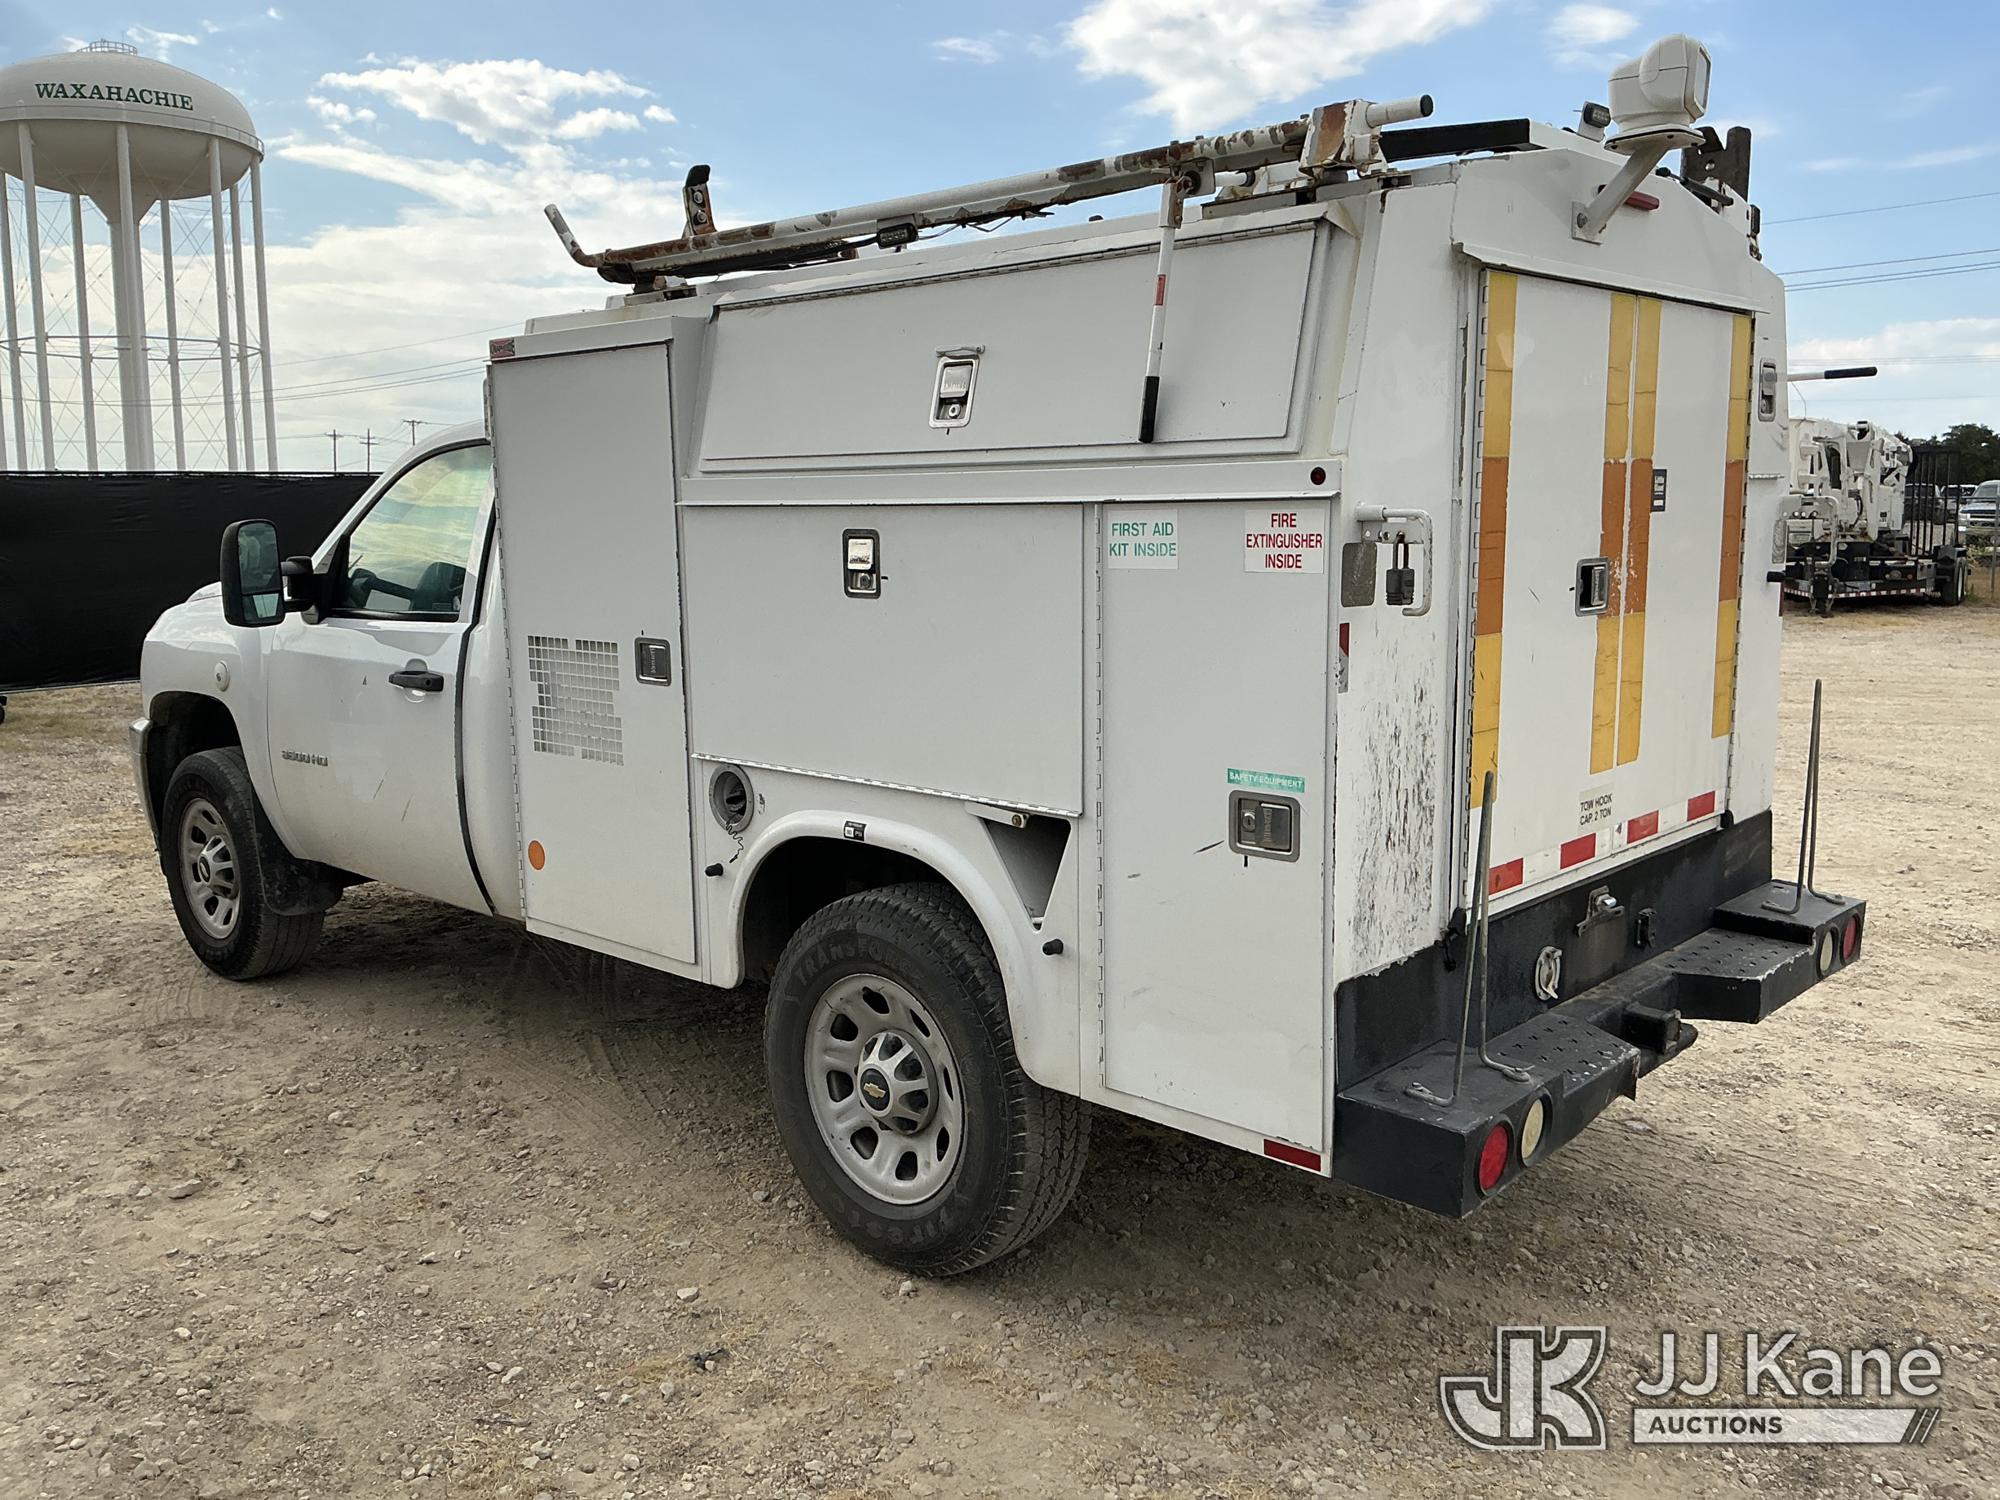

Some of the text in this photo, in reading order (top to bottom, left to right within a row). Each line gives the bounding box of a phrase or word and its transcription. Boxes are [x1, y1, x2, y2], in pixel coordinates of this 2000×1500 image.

[35, 83, 193, 110] WAXAHACHIE
[1270, 512, 1297, 528] FIRE
[1111, 522, 1174, 537] FIRST AID
[1245, 533, 1323, 548] EXTINGUISHER
[1109, 542, 1177, 557] KIT INSIDE
[1264, 554, 1302, 569] INSIDE
[1229, 771, 1303, 788] SAFETY EQUIPMENT
[1580, 793, 1612, 812] TOW HOOK
[1600, 807, 1611, 819] TON
